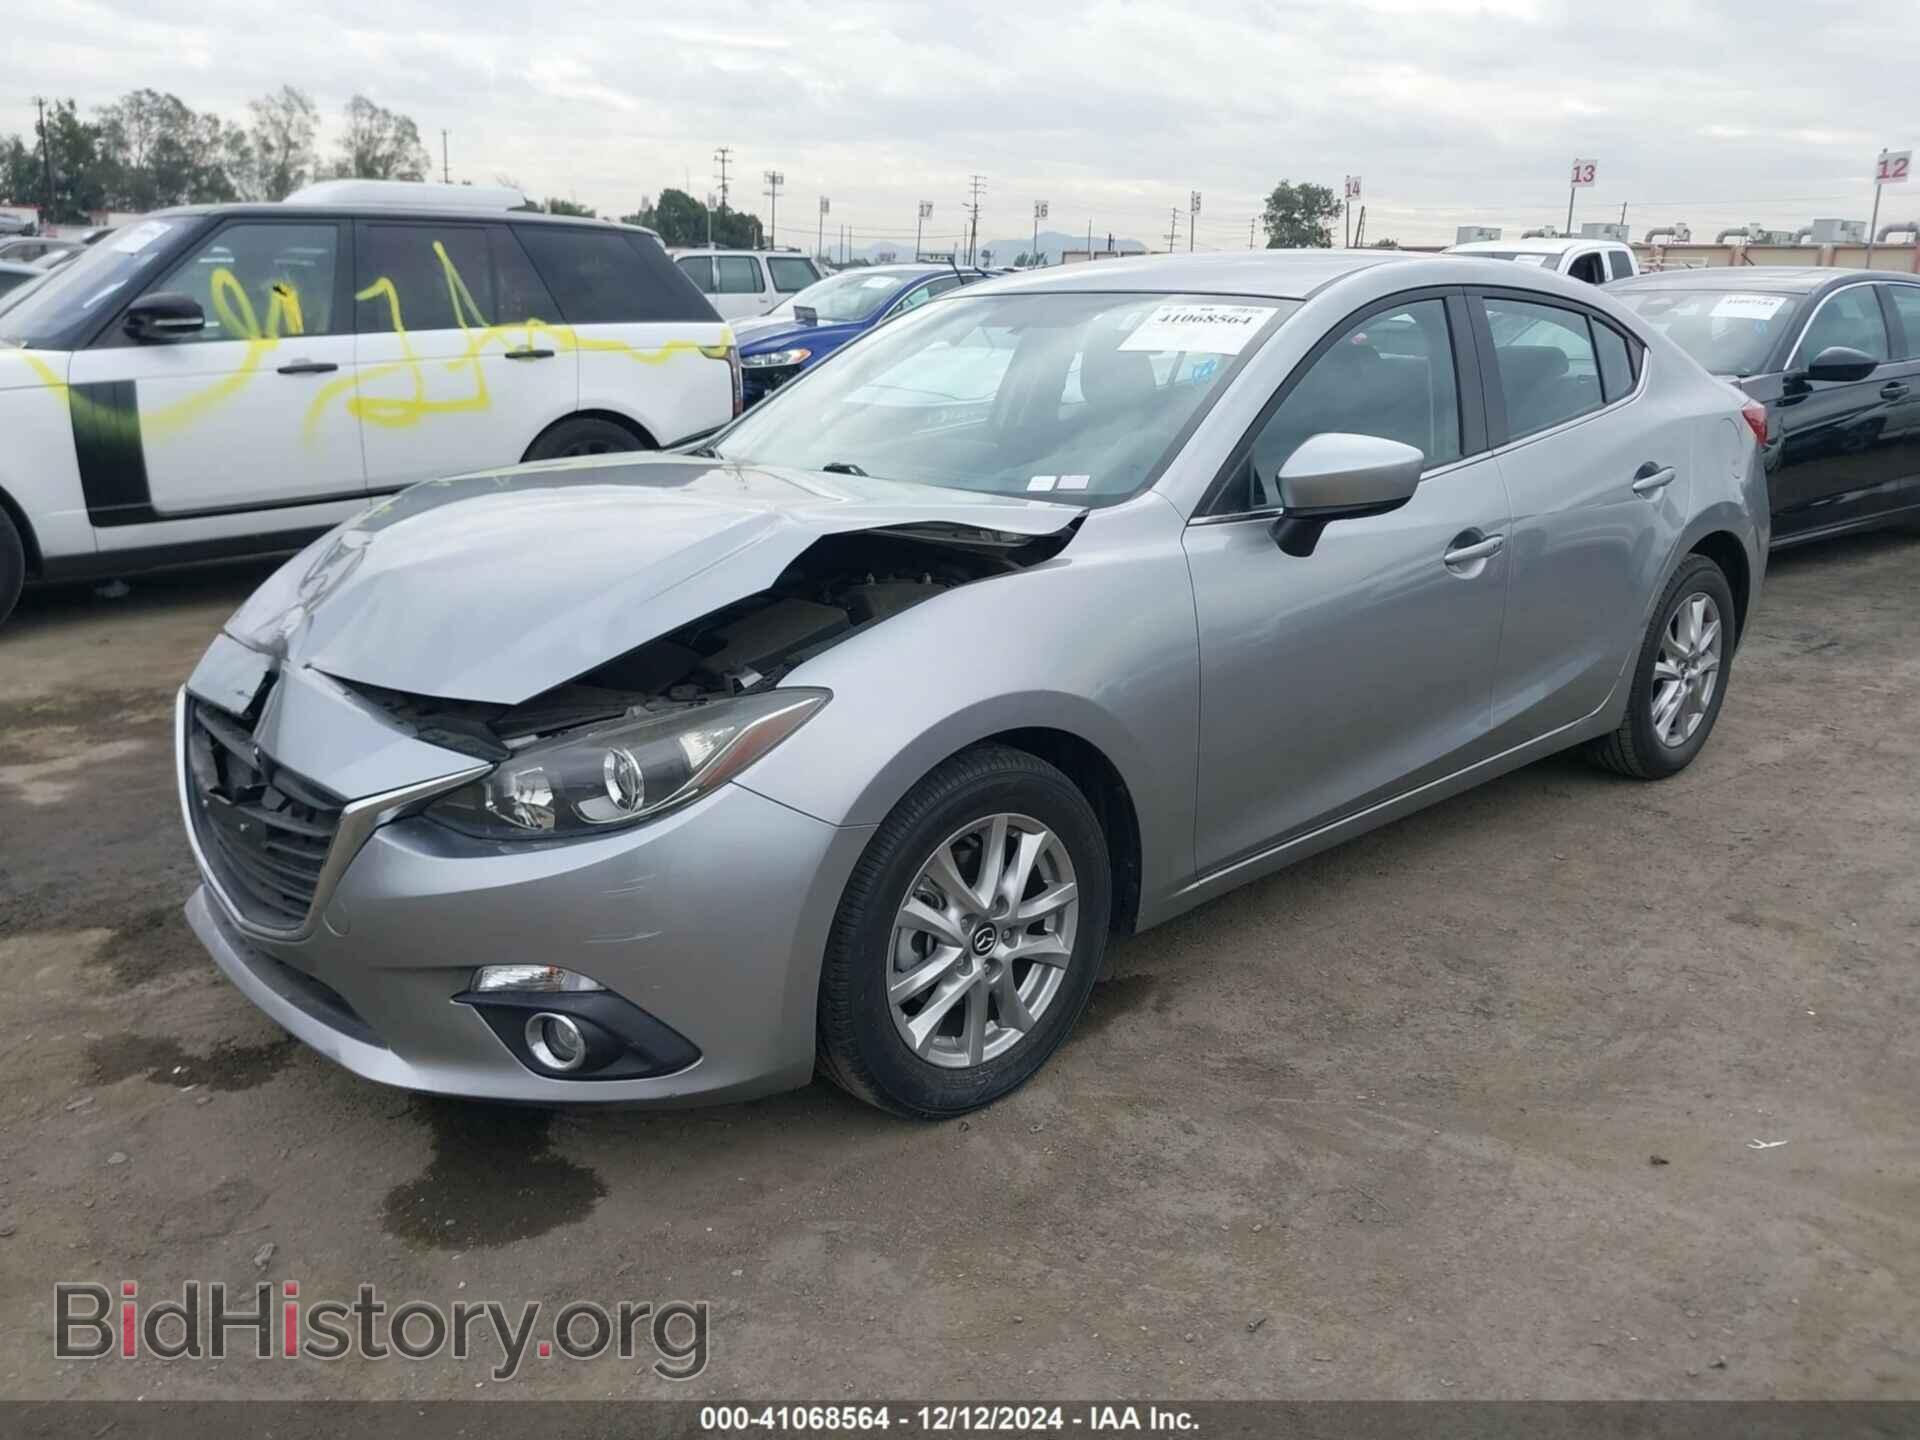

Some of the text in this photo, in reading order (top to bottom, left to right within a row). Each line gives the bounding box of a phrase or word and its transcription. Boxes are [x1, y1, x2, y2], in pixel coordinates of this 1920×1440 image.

[1571, 164, 1596, 183] 13
[1876, 157, 1910, 180] 12
[1344, 180, 1361, 198] 14
[919, 203, 934, 218] 17
[1033, 203, 1049, 219] 16
[1158, 313, 1253, 326] 41068564
